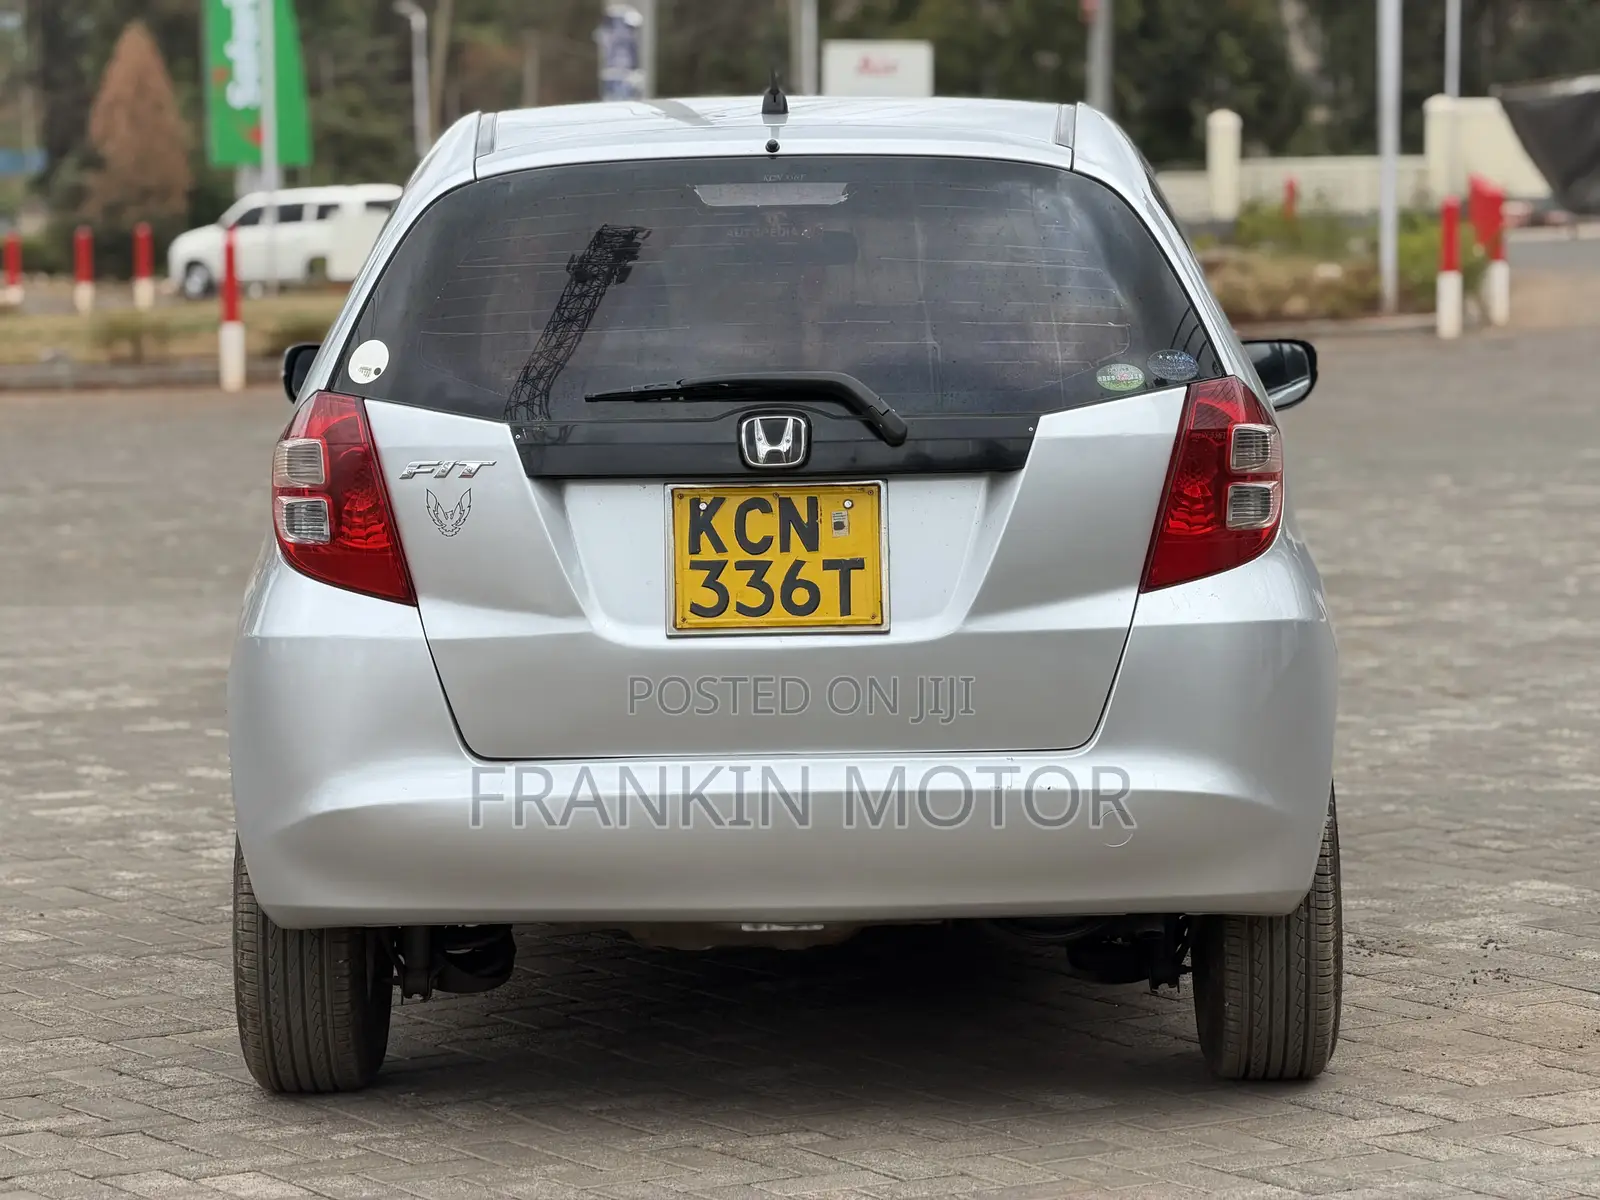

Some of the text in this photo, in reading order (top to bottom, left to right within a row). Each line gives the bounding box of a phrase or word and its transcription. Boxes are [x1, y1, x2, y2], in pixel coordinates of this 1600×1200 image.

[399, 459, 498, 480] FIT
[688, 496, 820, 556] KCN
[688, 557, 866, 618] 336T
